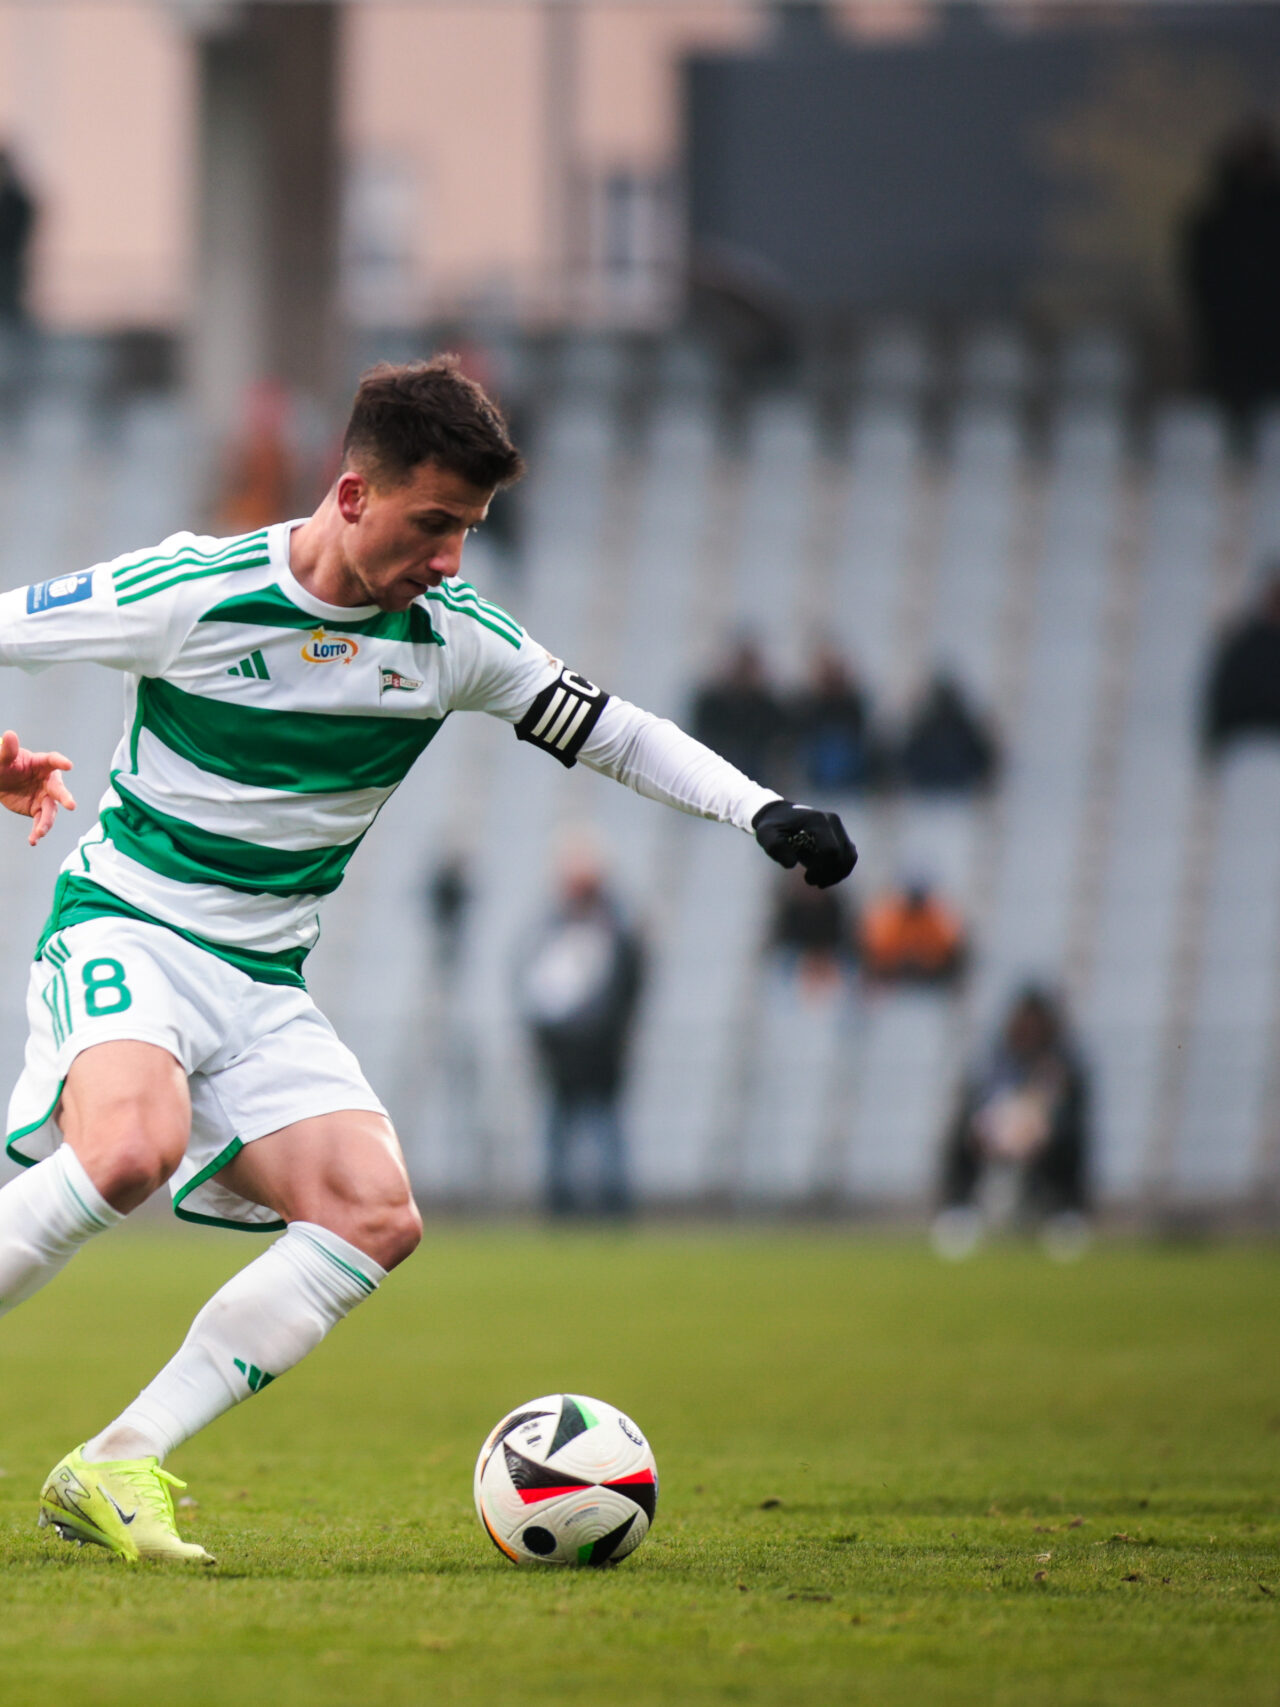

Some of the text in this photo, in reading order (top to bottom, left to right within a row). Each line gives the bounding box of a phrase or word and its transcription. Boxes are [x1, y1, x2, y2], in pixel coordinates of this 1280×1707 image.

[313, 643, 347, 657] LOTTO
[561, 669, 601, 698] C
[82, 957, 132, 1017] 8
